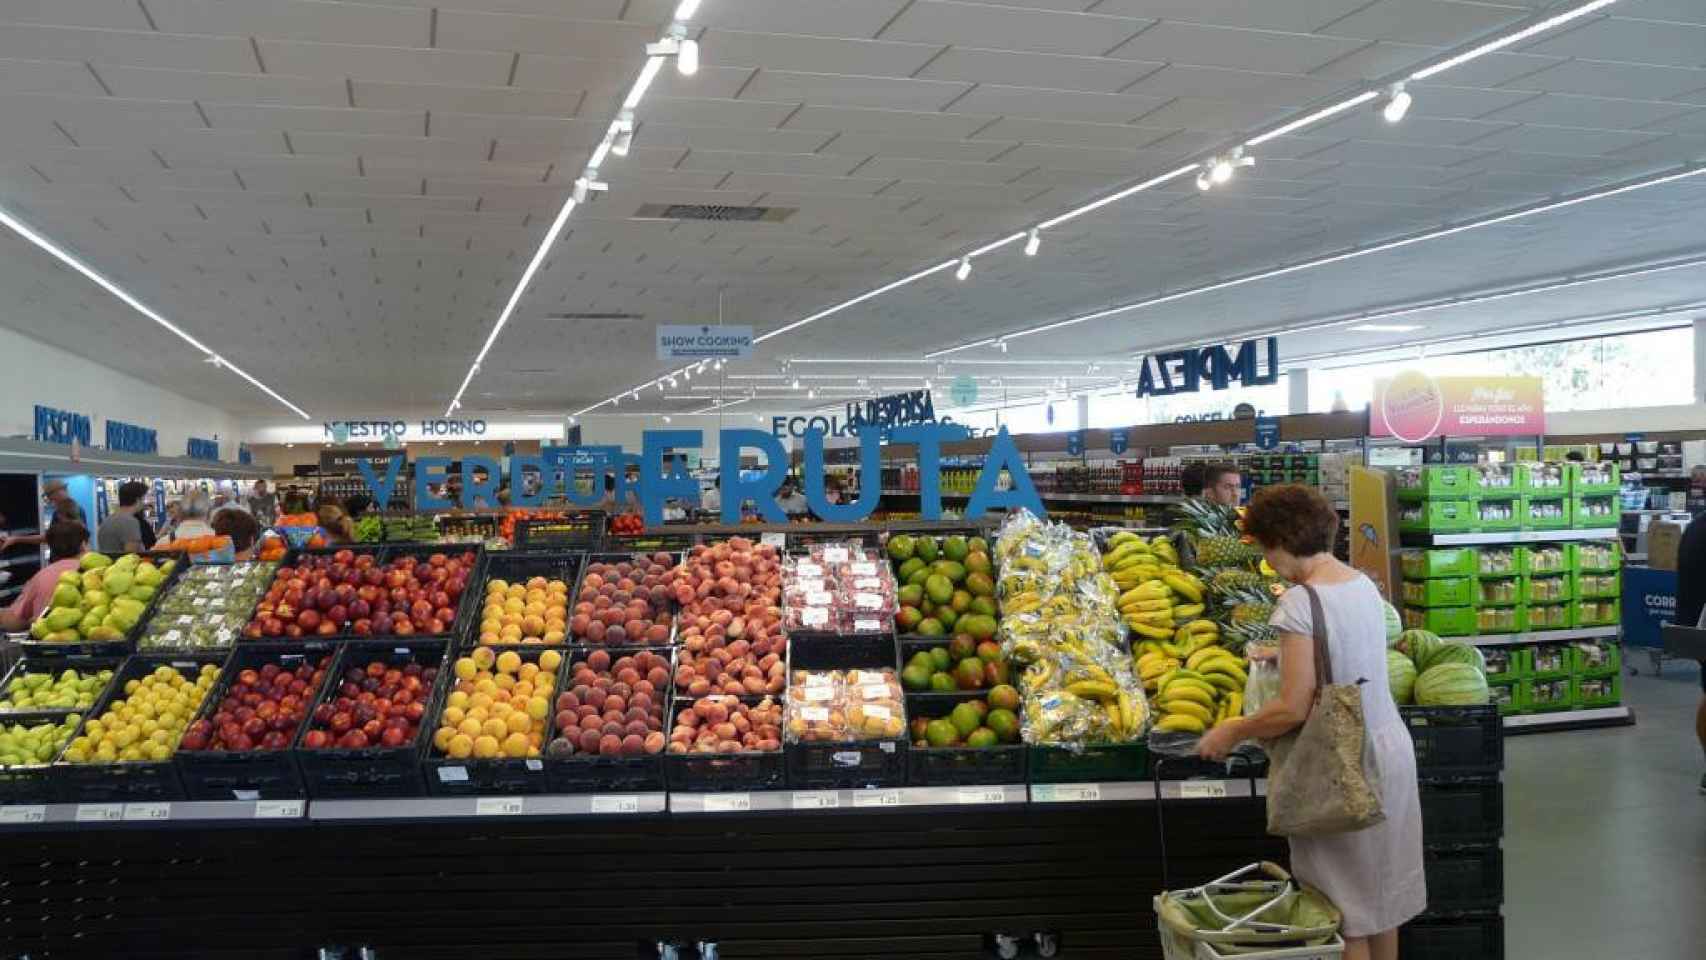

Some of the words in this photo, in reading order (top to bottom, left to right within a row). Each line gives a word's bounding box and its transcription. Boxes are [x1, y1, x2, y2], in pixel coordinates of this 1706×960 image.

[661, 335, 695, 346] SHOW
[697, 335, 750, 347] COOKING
[422, 419, 486, 436] HORNO
[642, 424, 1048, 526] FRUTA
[1645, 594, 1678, 608] CORR
